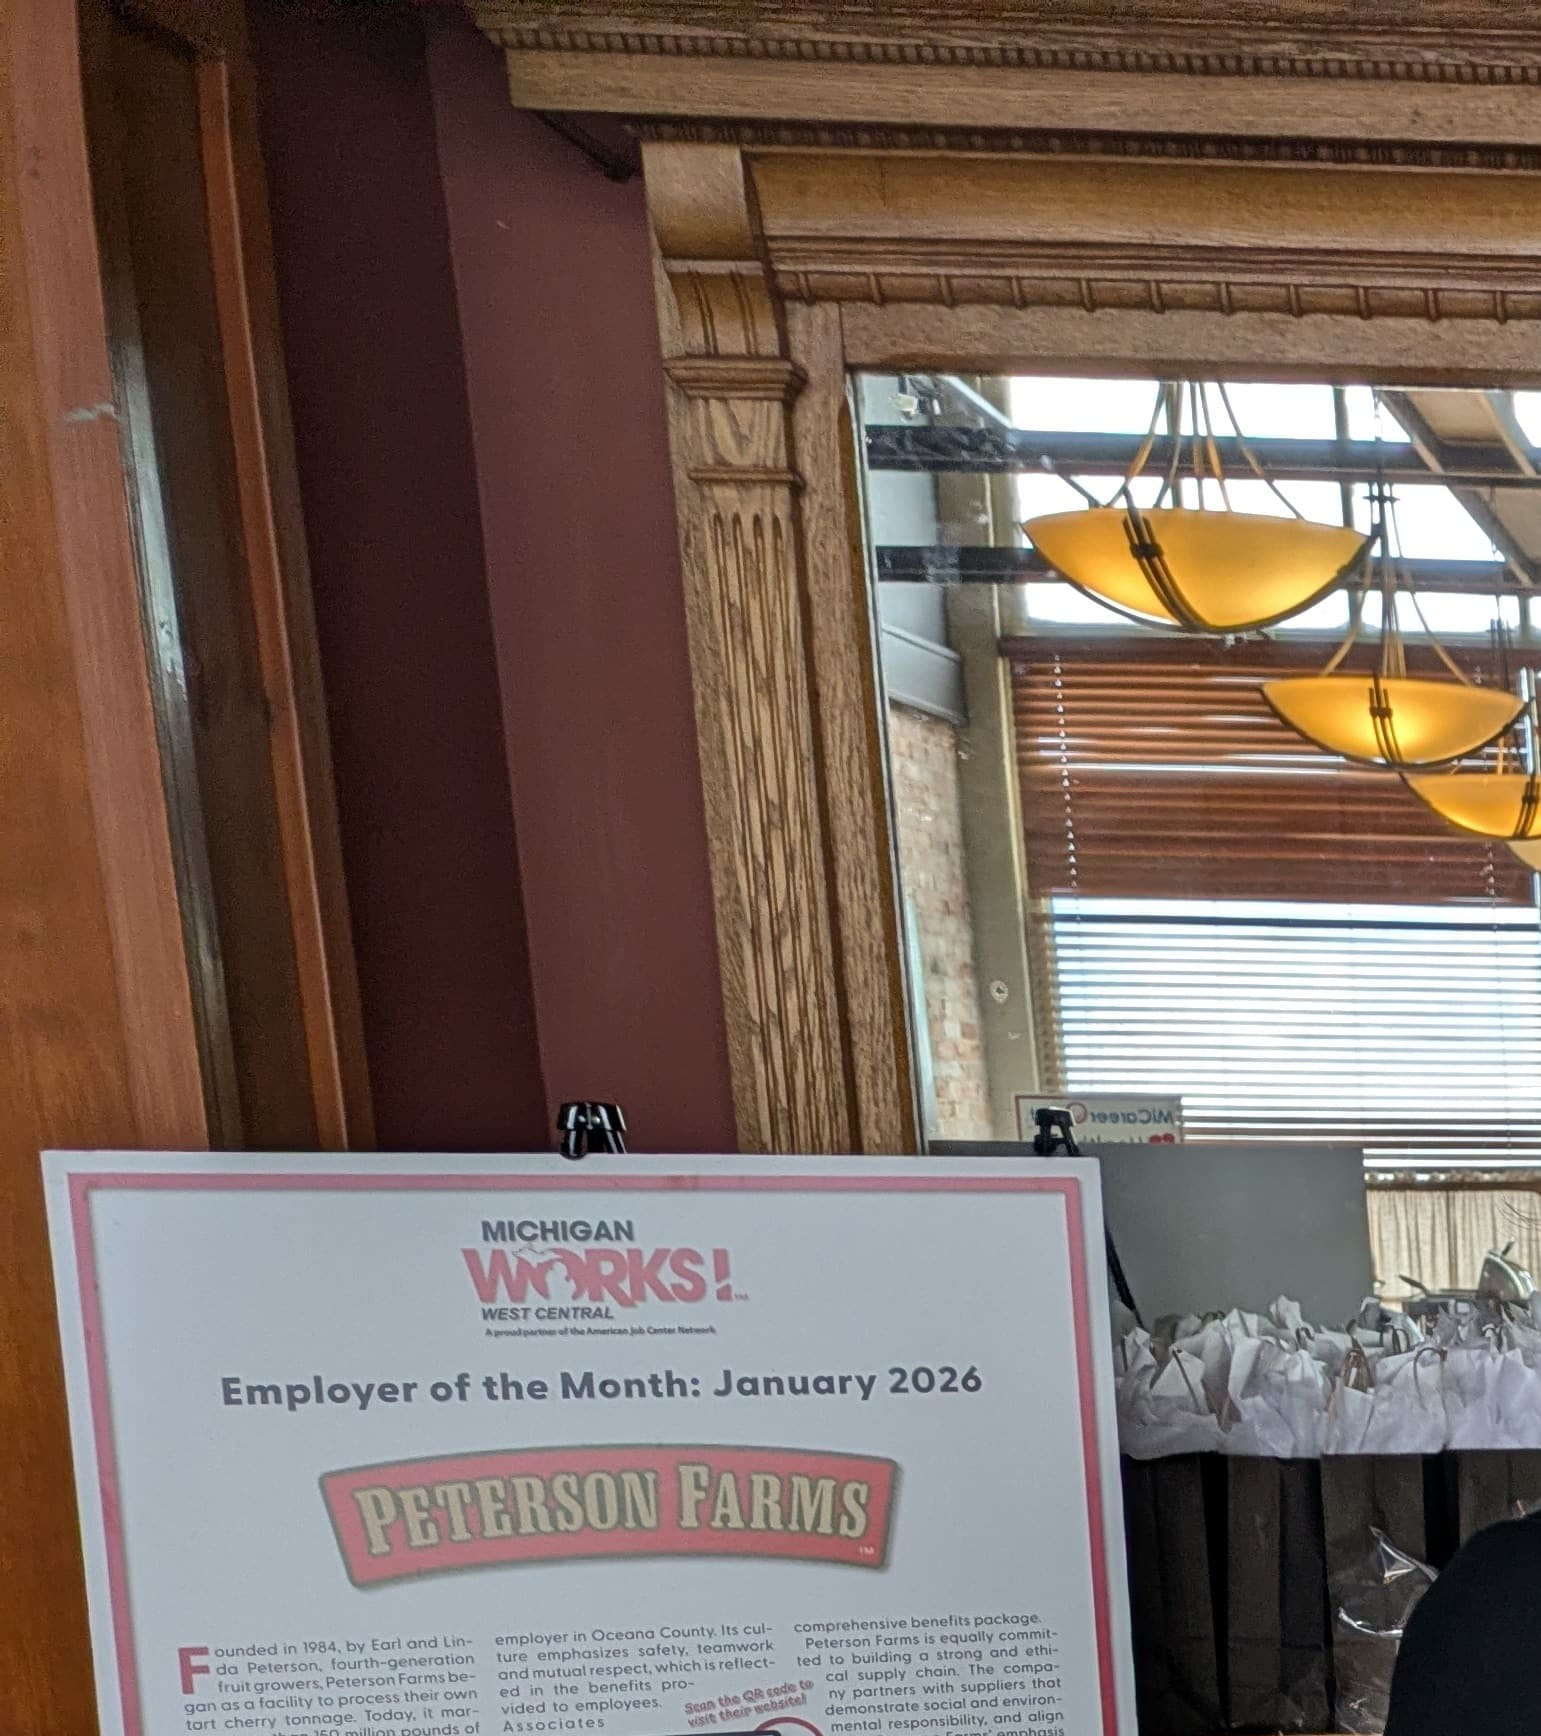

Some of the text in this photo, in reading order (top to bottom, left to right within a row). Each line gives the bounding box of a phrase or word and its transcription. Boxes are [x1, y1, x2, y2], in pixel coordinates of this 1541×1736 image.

[481, 1220, 635, 1242] MICHIGAN
[461, 1248, 733, 1308] WORKS!
[482, 1306, 615, 1320] WEST CENTRAL
[494, 1328, 521, 1338] proud
[523, 1328, 557, 1338] partner
[570, 1327, 585, 1336] the
[587, 1326, 629, 1336] American
[630, 1325, 645, 1337] Job
[647, 1325, 675, 1335] Center
[677, 1324, 717, 1335] Network
[221, 1365, 982, 1412] Employer of the Month: January 2026
[353, 1463, 871, 1556] PETERSON FARMS
[793, 1613, 1041, 1633] comprehensive benefits package.
[805, 1628, 1057, 1648] Peterson Farms is equally commit-
[496, 1639, 773, 1663] ture emphasizes safety, teamwork
[216, 1653, 474, 1675] da Peterson, fourth-generation
[825, 1663, 1059, 1682] cal supply chain. The compa-
[499, 1679, 694, 1697] ed in the benefits pro-
[684, 1679, 815, 1714] Scan the QR code to
[824, 1694, 1062, 1715] demonstrate social and environ-
[688, 1713, 718, 1728] visit
[719, 1706, 752, 1721] their
